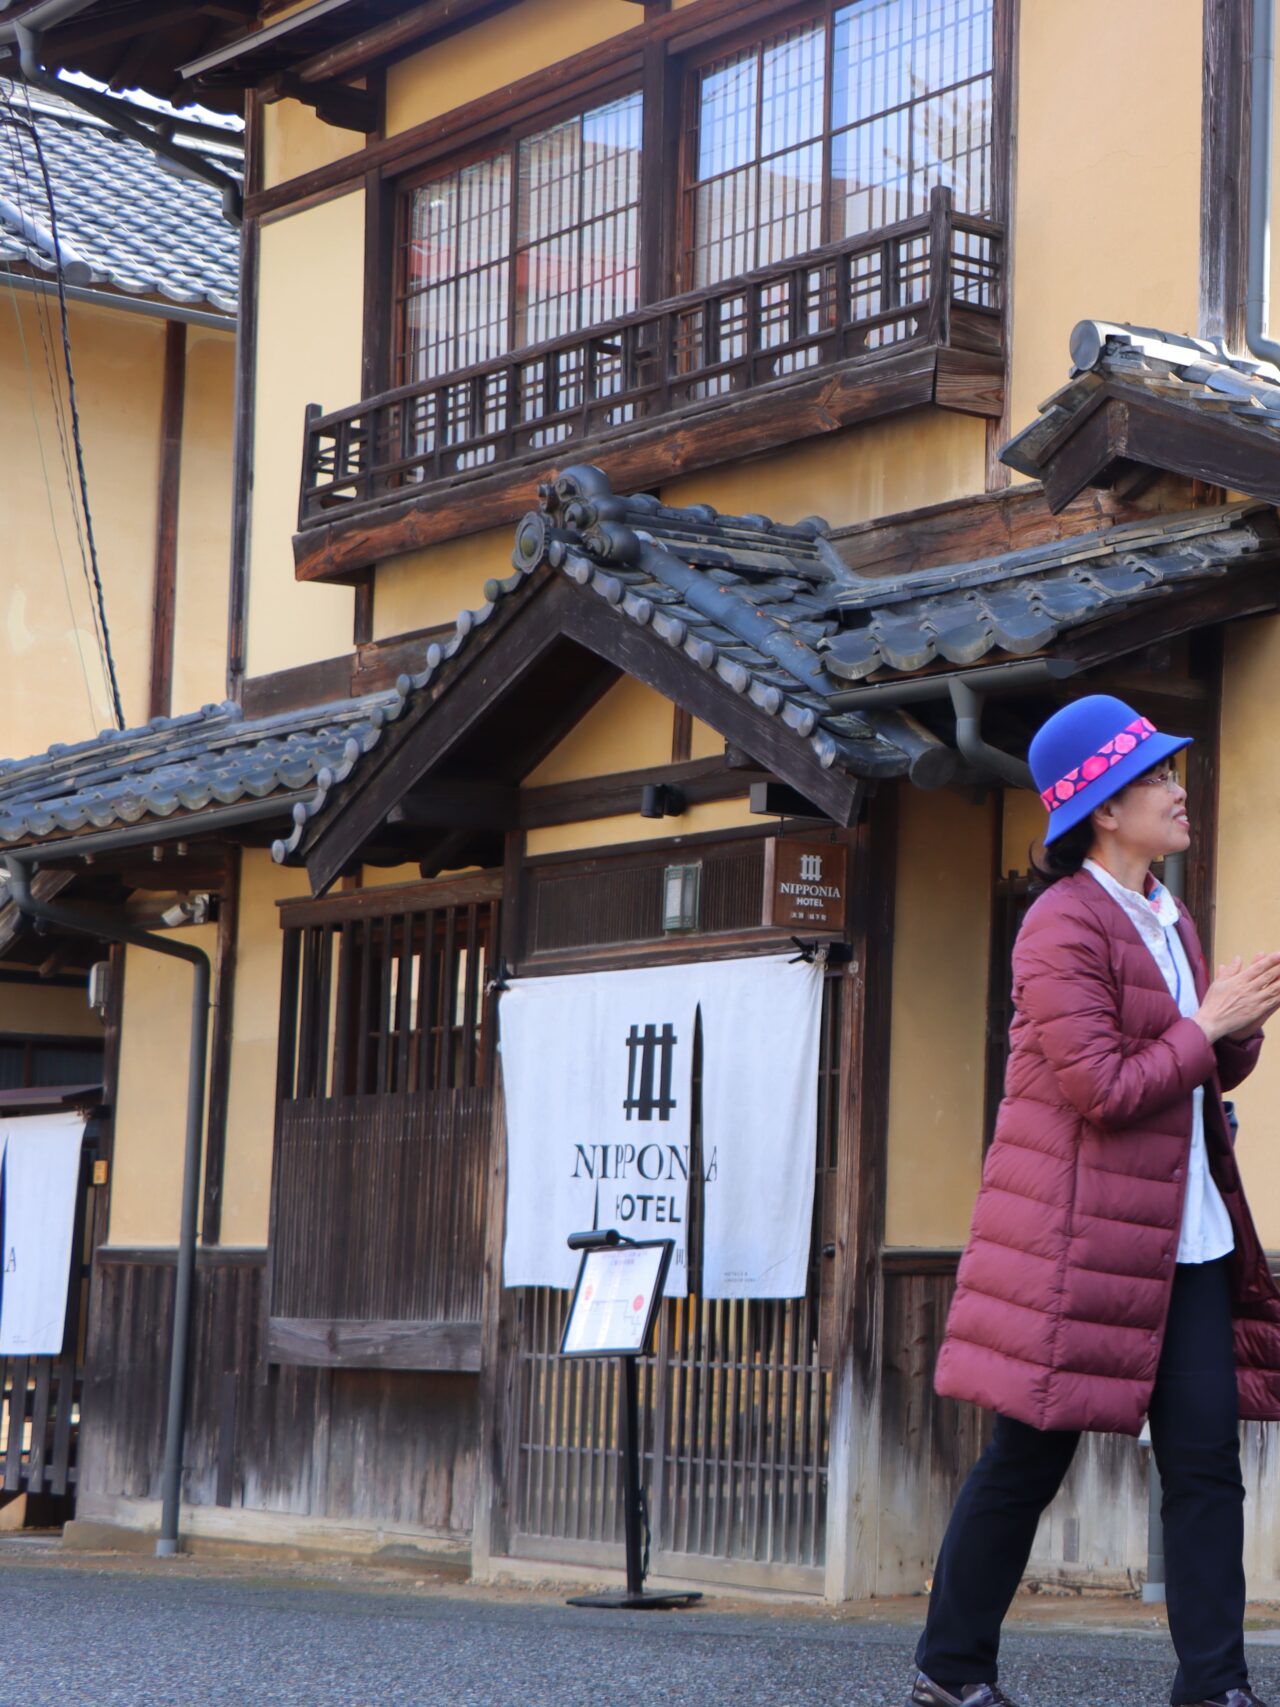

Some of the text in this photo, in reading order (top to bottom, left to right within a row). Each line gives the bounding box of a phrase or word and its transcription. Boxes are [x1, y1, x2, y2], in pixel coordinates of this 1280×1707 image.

[780, 883, 841, 898] NIPPONIA
[797, 897, 824, 907] HOTEL
[570, 1143, 718, 1182] NIPPONA
